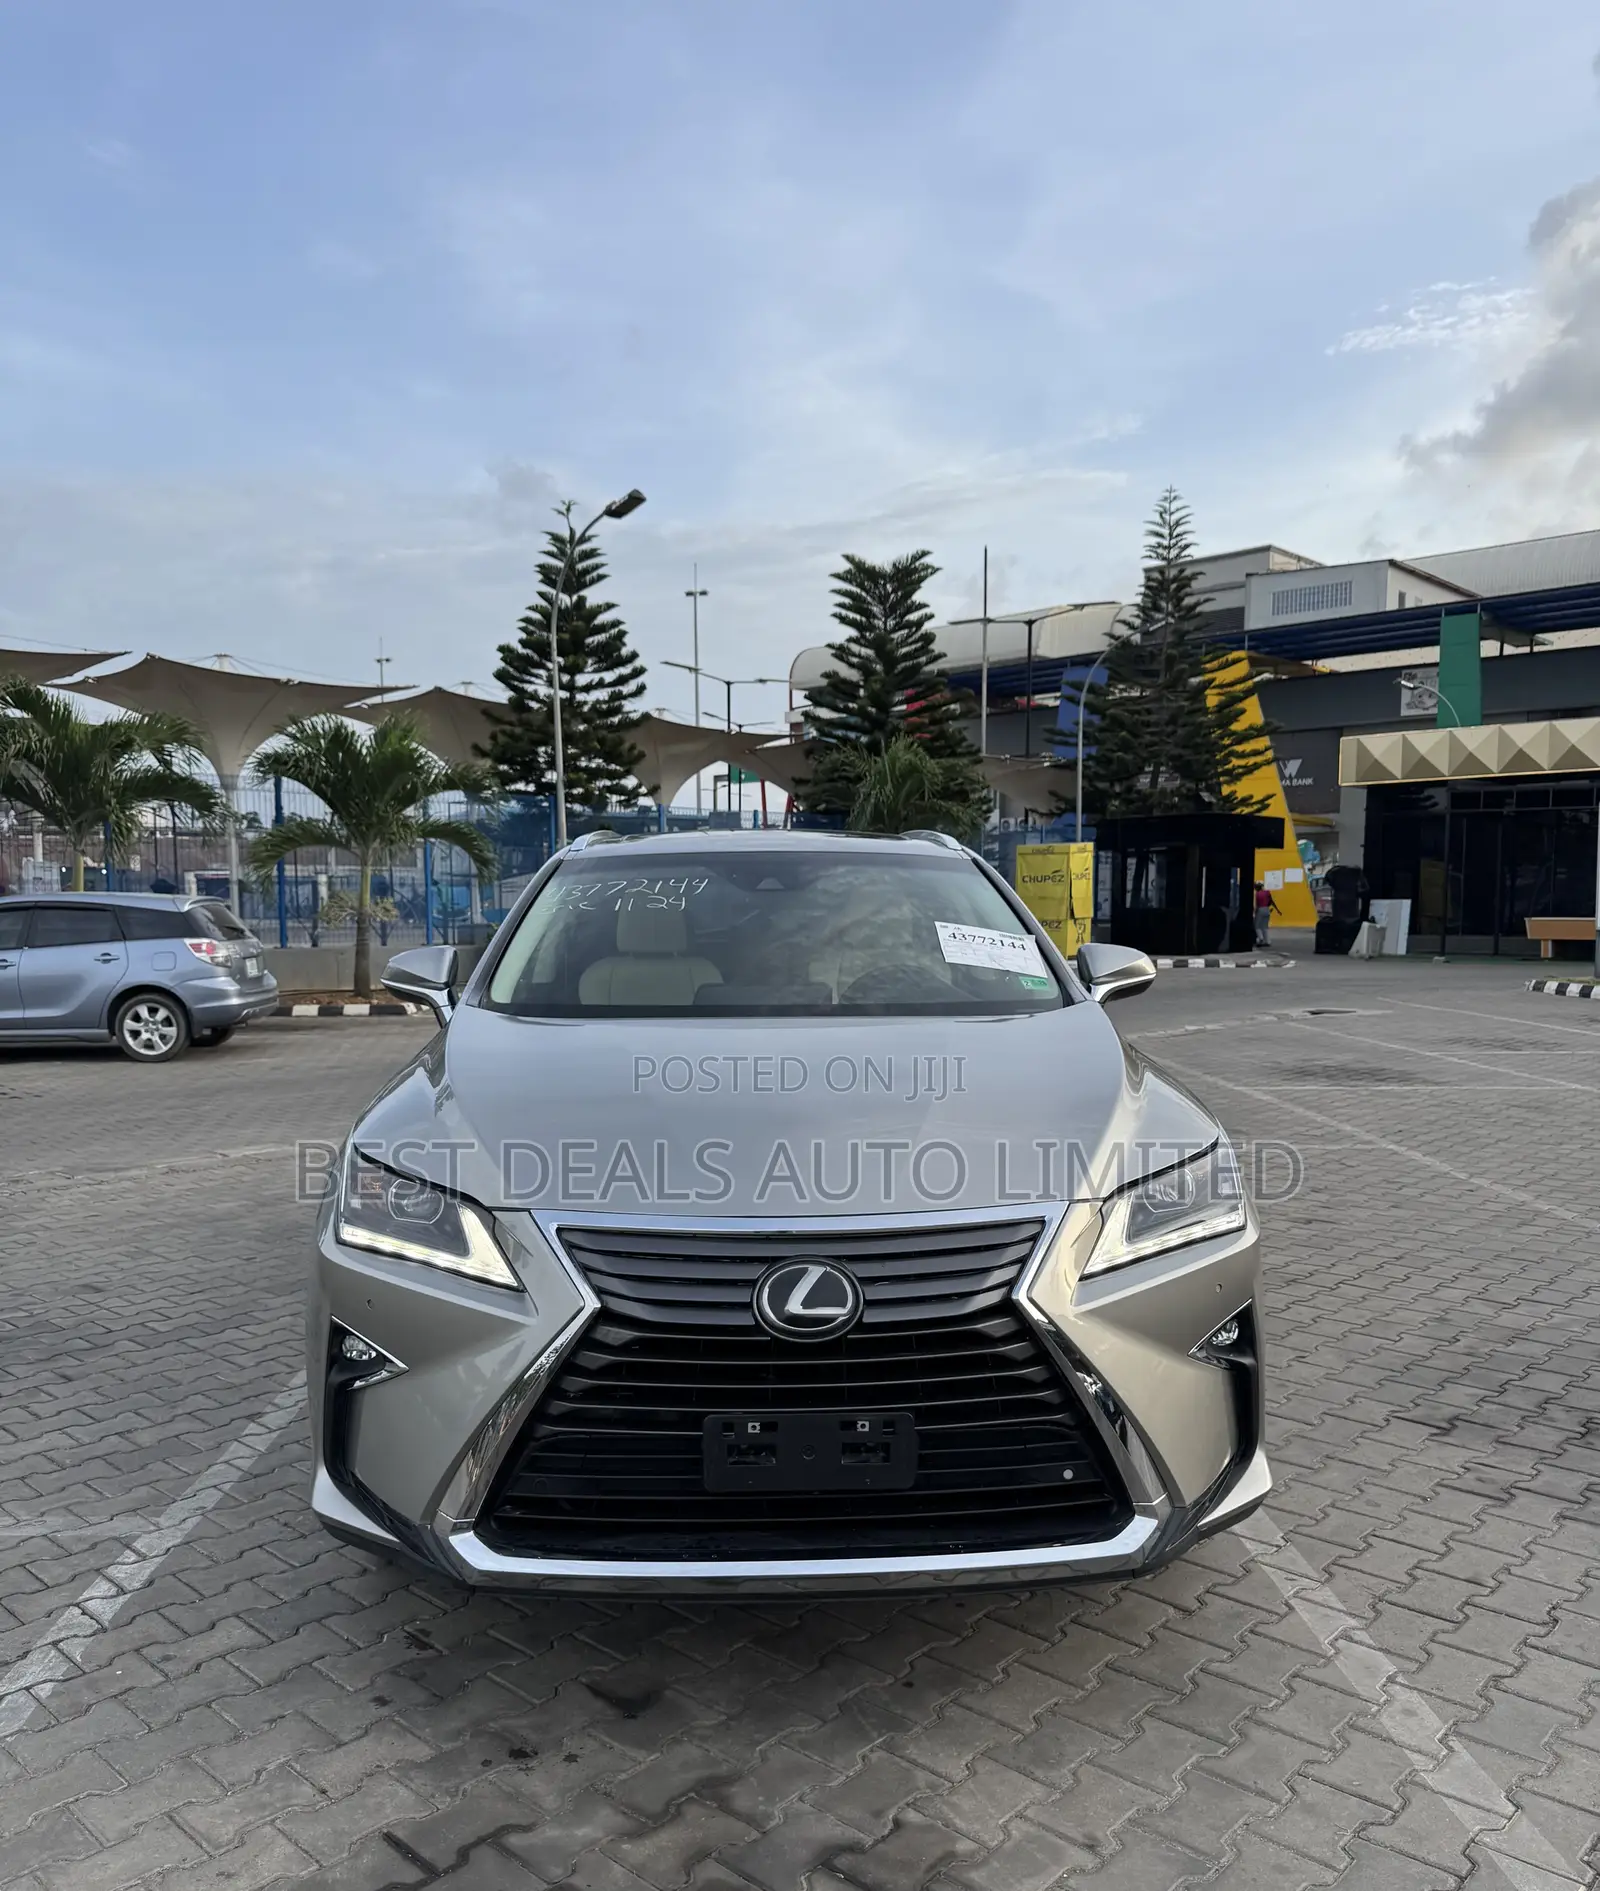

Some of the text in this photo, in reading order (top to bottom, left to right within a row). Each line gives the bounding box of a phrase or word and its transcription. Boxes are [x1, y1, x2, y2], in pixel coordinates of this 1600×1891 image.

[1292, 777, 1314, 787] BANK
[1022, 873, 1065, 884] CHUPEZ
[646, 896, 687, 912] 24
[1041, 921, 1063, 930] PEZ
[948, 932, 1027, 951] 43772144
